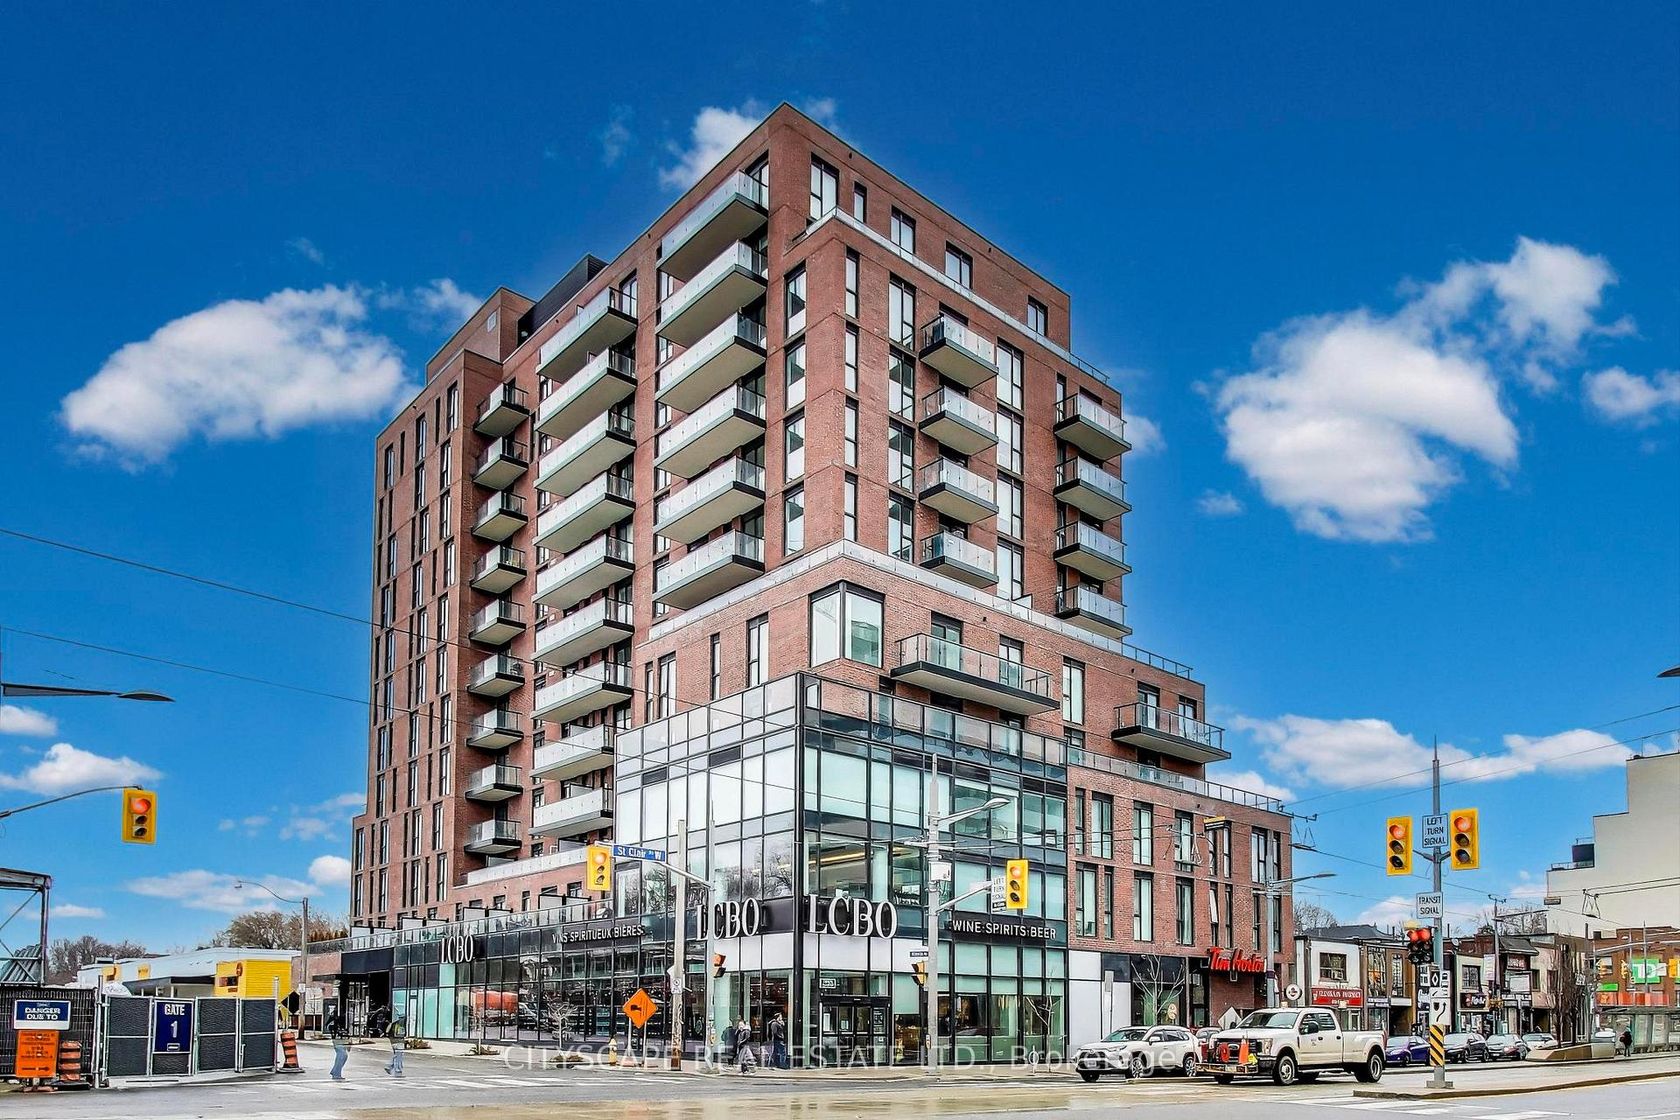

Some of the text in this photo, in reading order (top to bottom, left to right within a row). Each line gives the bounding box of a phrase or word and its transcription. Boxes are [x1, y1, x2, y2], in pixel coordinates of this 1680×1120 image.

[1426, 827, 1444, 835] TURN
[1424, 837, 1446, 846] SIGNAL
[617, 846, 626, 857] St
[628, 847, 646, 858] Clair
[697, 897, 760, 941] LCBO
[808, 894, 898, 939] LCBO
[441, 935, 474, 964] LCBO
[1209, 946, 1230, 970] Tim
[164, 1003, 186, 1016] GATE
[170, 1020, 178, 1038] 1
